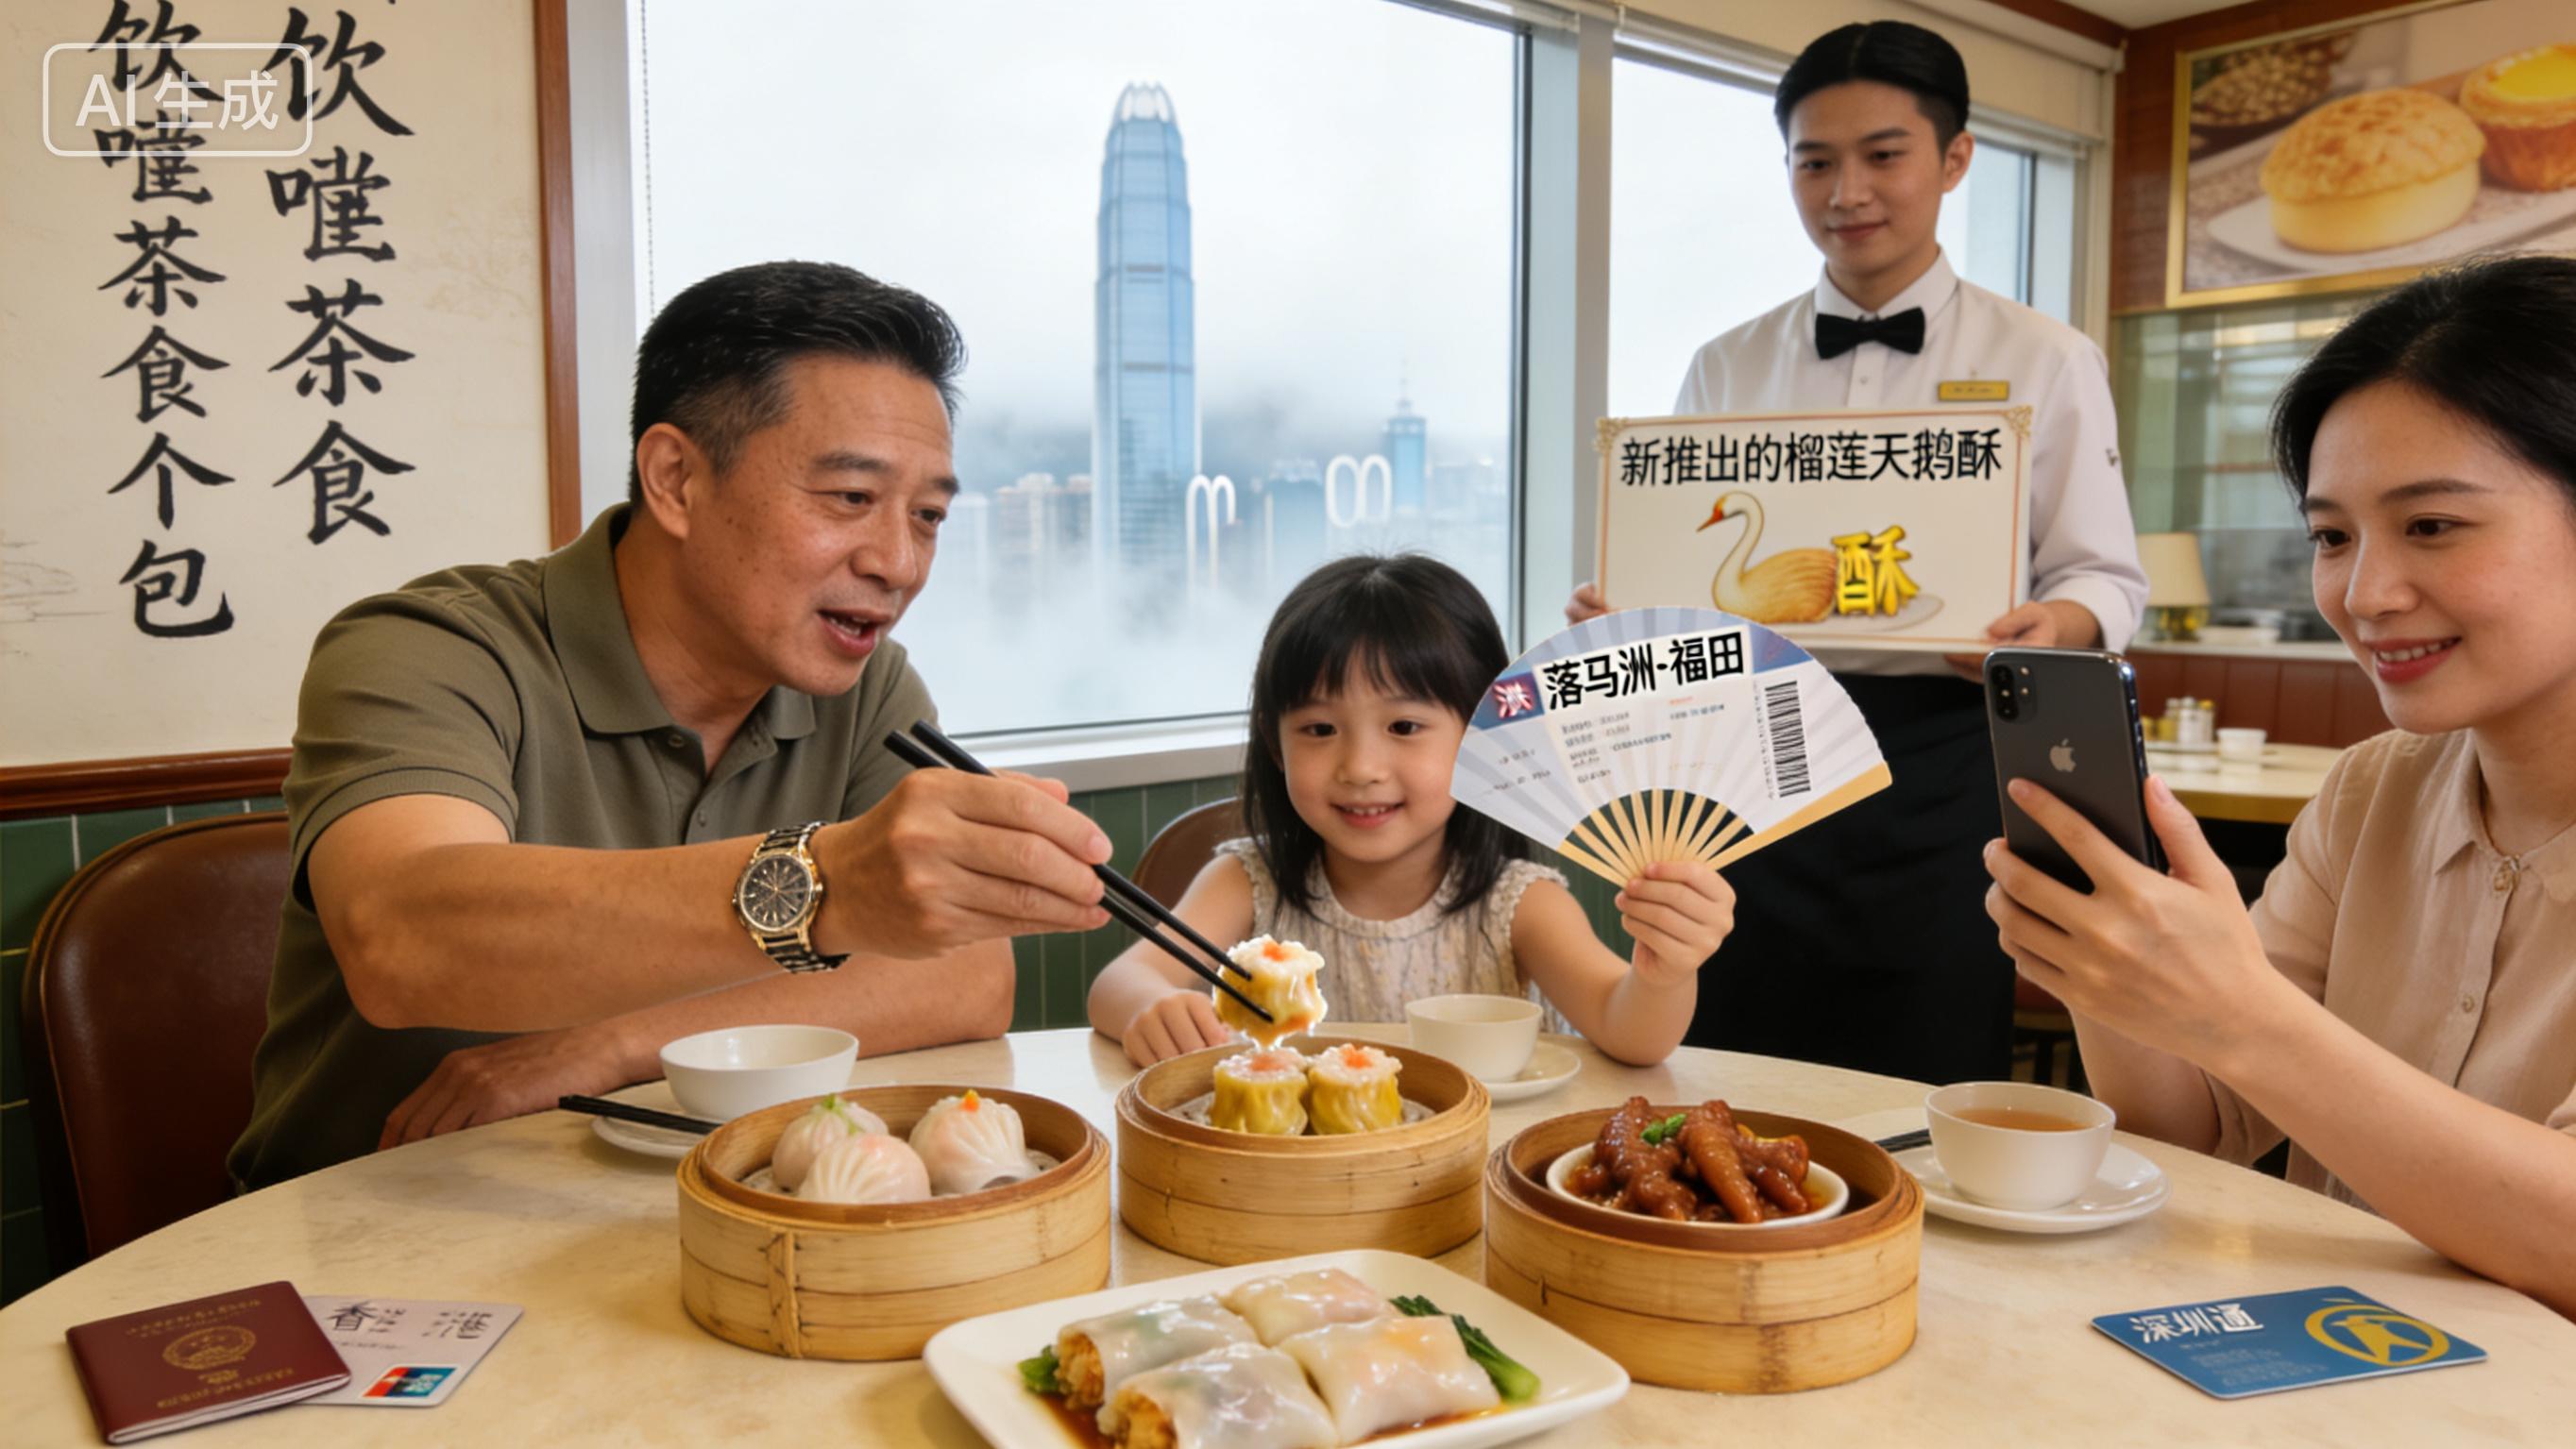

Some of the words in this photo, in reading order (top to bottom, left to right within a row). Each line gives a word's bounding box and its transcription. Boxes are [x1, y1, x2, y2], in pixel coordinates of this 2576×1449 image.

[1620, 428, 2003, 487] 新推出的榴莲天鹅酥
[1543, 632, 1744, 710] 落马洲-福田
[2129, 1303, 2264, 1344] 深圳通
